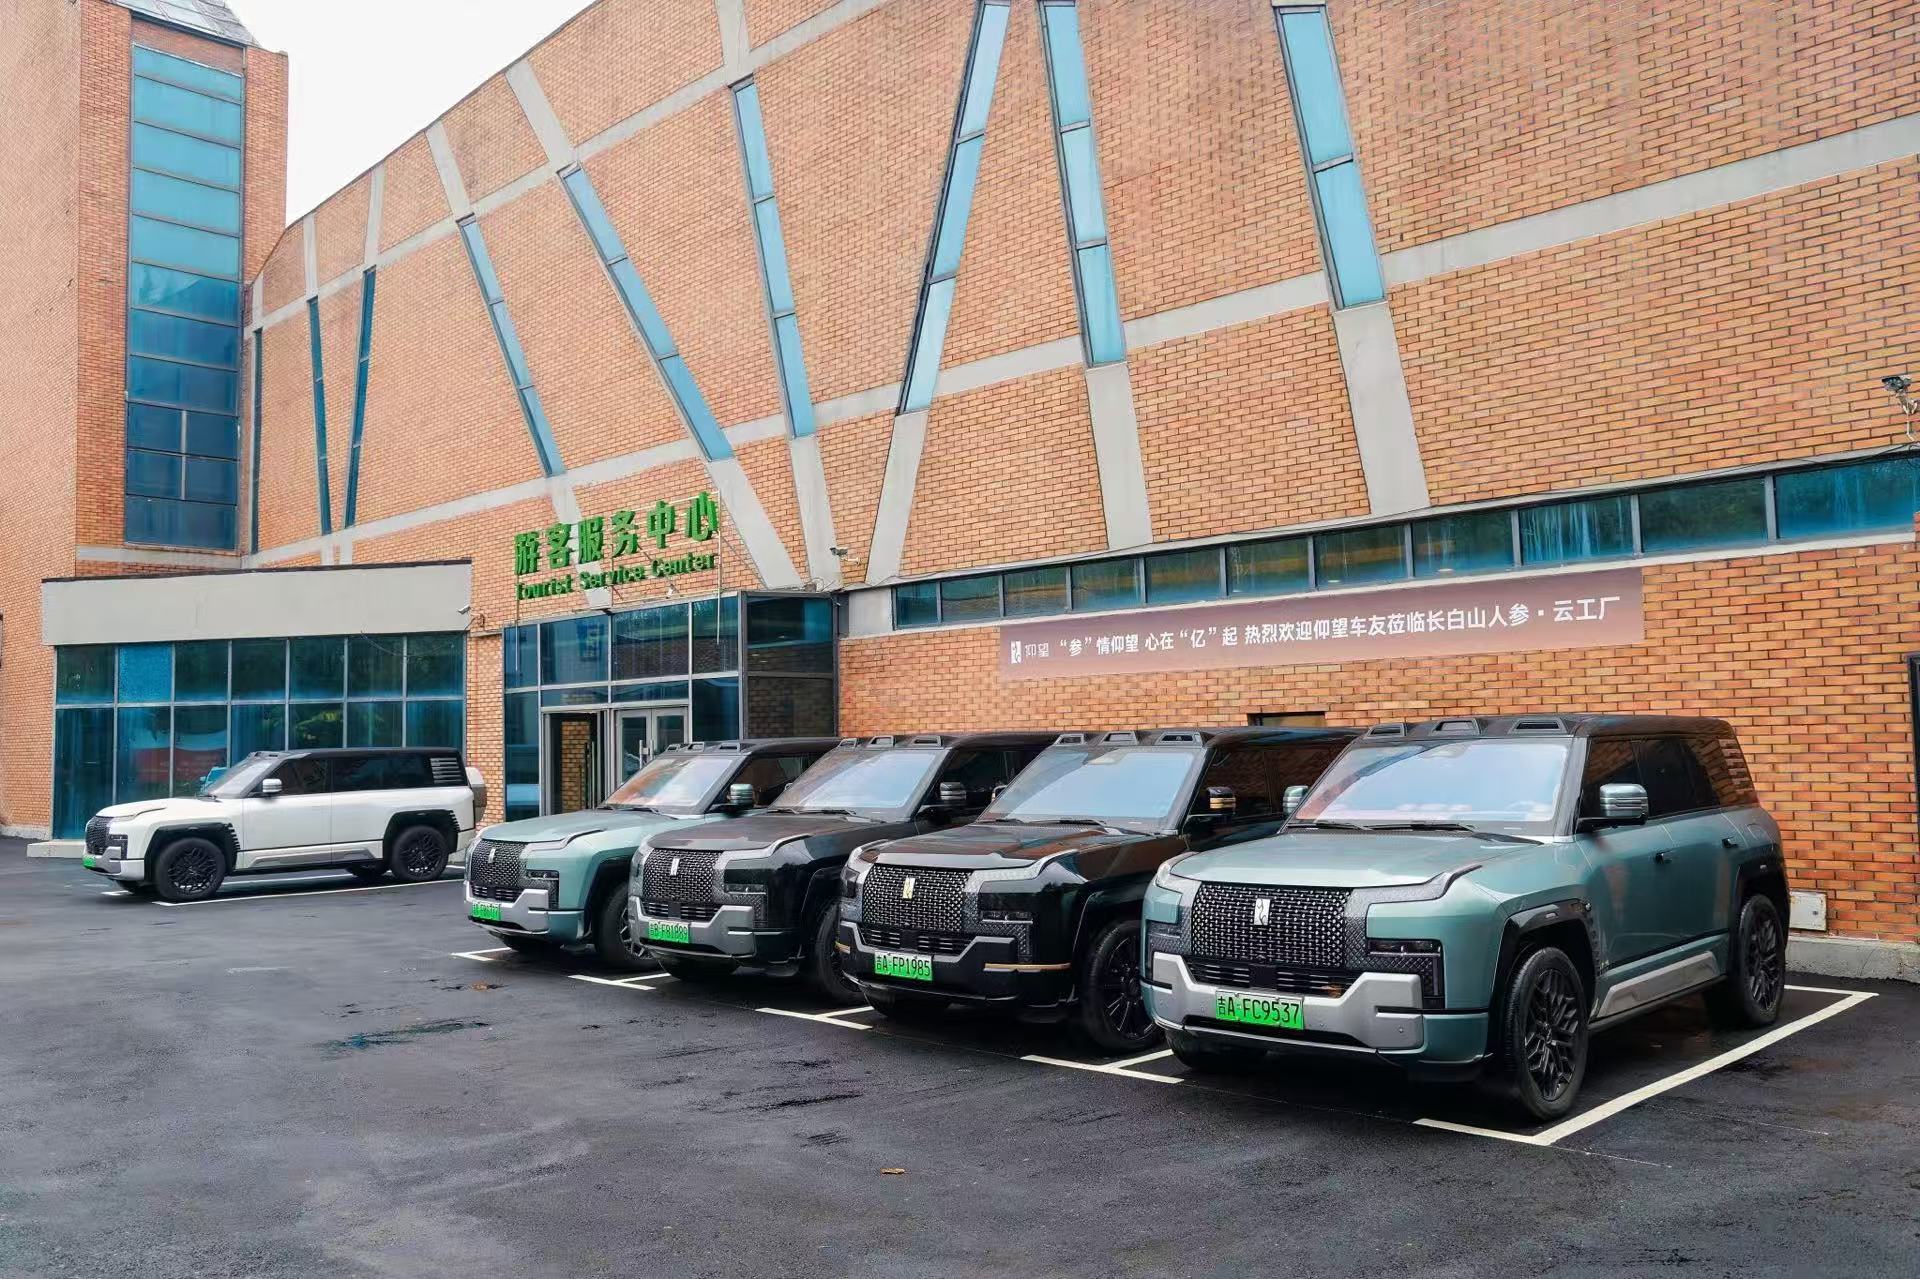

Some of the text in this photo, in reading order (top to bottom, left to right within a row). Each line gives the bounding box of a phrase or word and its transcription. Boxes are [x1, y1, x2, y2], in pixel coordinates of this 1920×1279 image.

[514, 491, 719, 575] 游客服务中心
[516, 552, 717, 600] Tourist Service Center
[1025, 643, 1049, 657] 仰望
